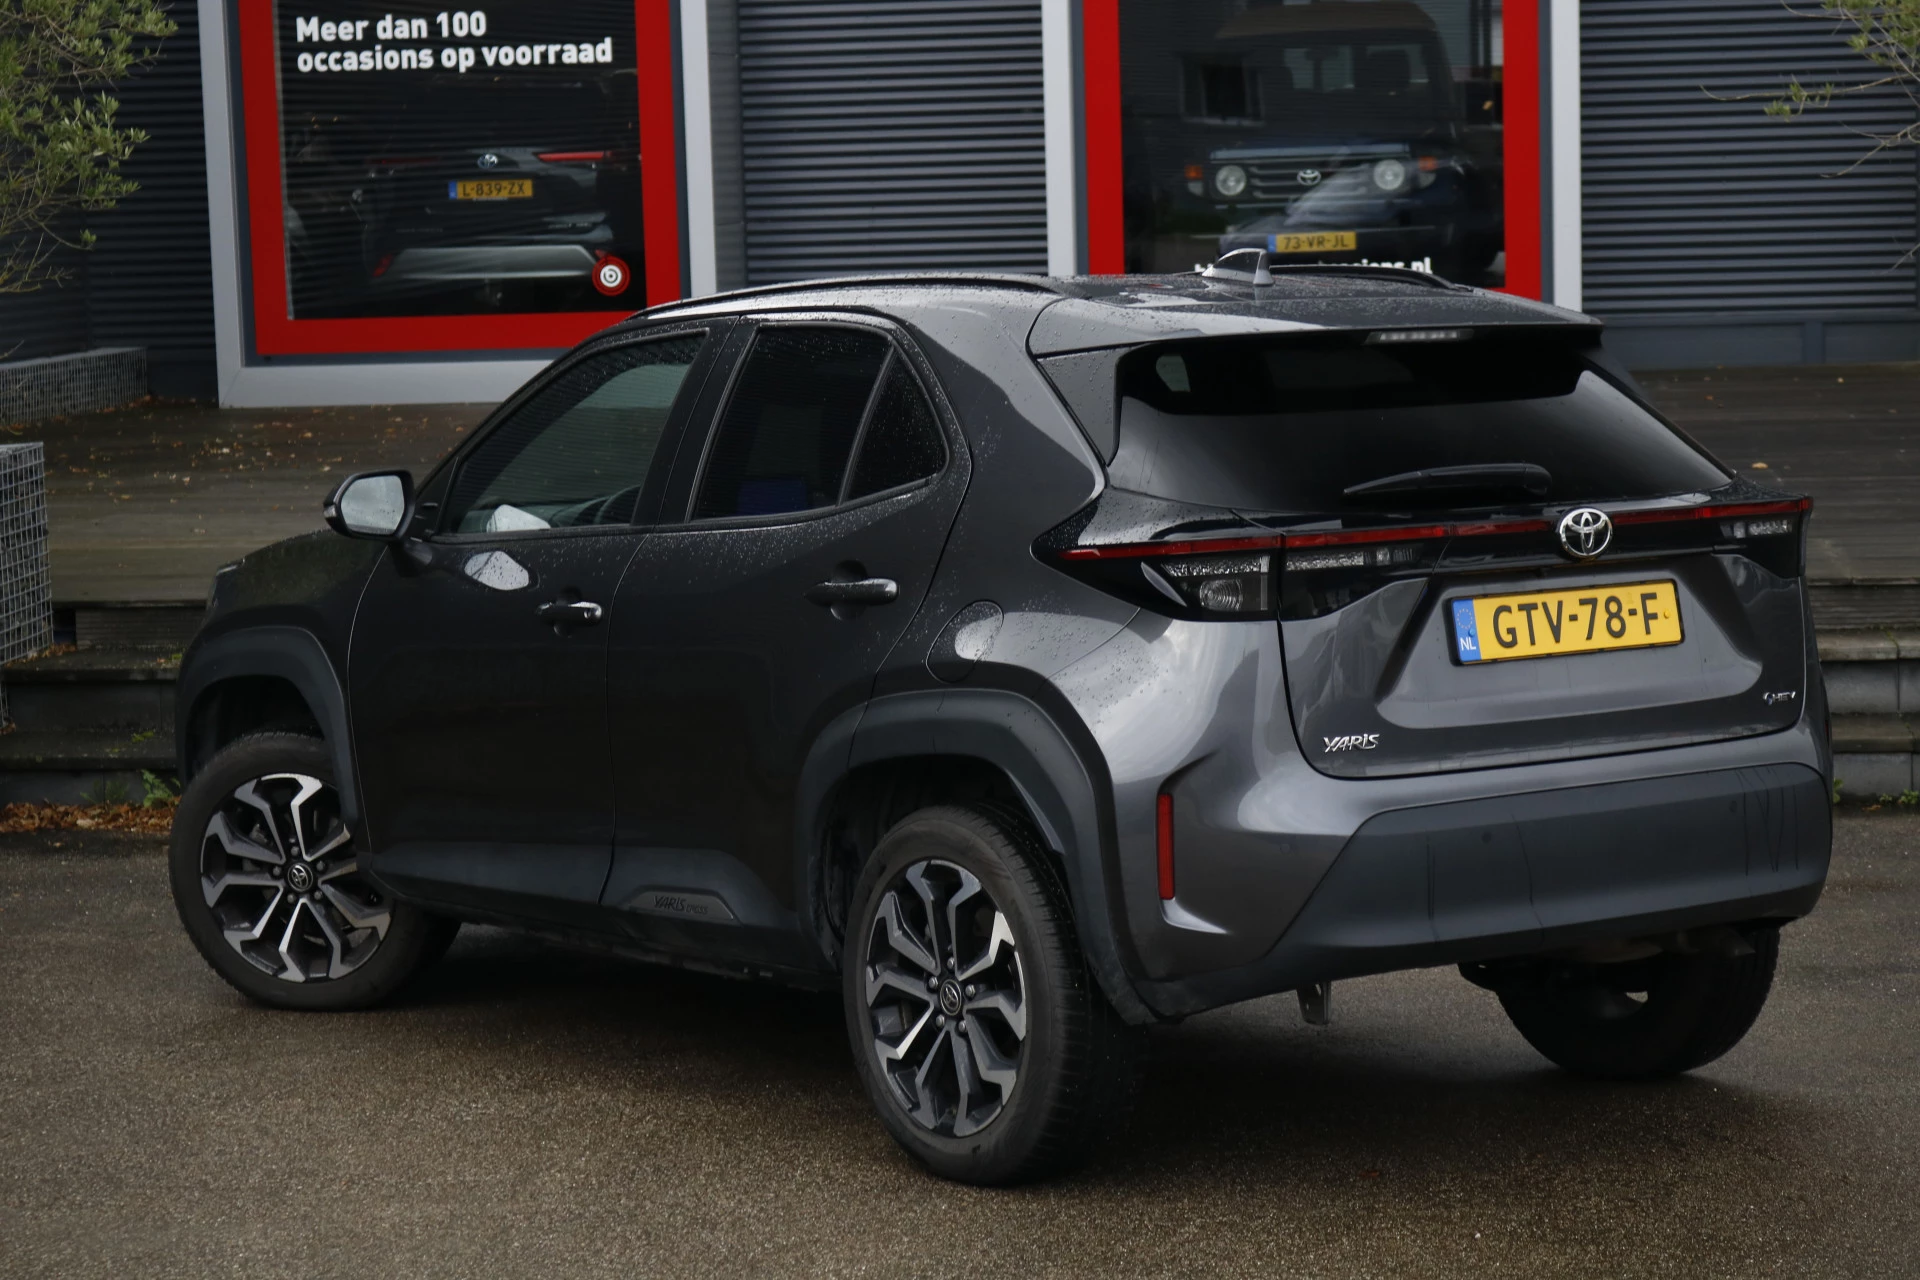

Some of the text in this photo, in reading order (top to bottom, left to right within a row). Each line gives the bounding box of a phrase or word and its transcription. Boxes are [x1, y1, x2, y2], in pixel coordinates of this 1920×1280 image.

[297, 11, 486, 42] Meer dan 100
[298, 37, 613, 73] occasions op voorraad
[462, 181, 525, 197] L-839-ZX
[1283, 233, 1349, 250] 73-VR-JL
[1492, 592, 1659, 649] GTV-78-F
[1460, 636, 1477, 651] NL
[1323, 733, 1380, 753] YARIS
[654, 895, 687, 912] YARIS
